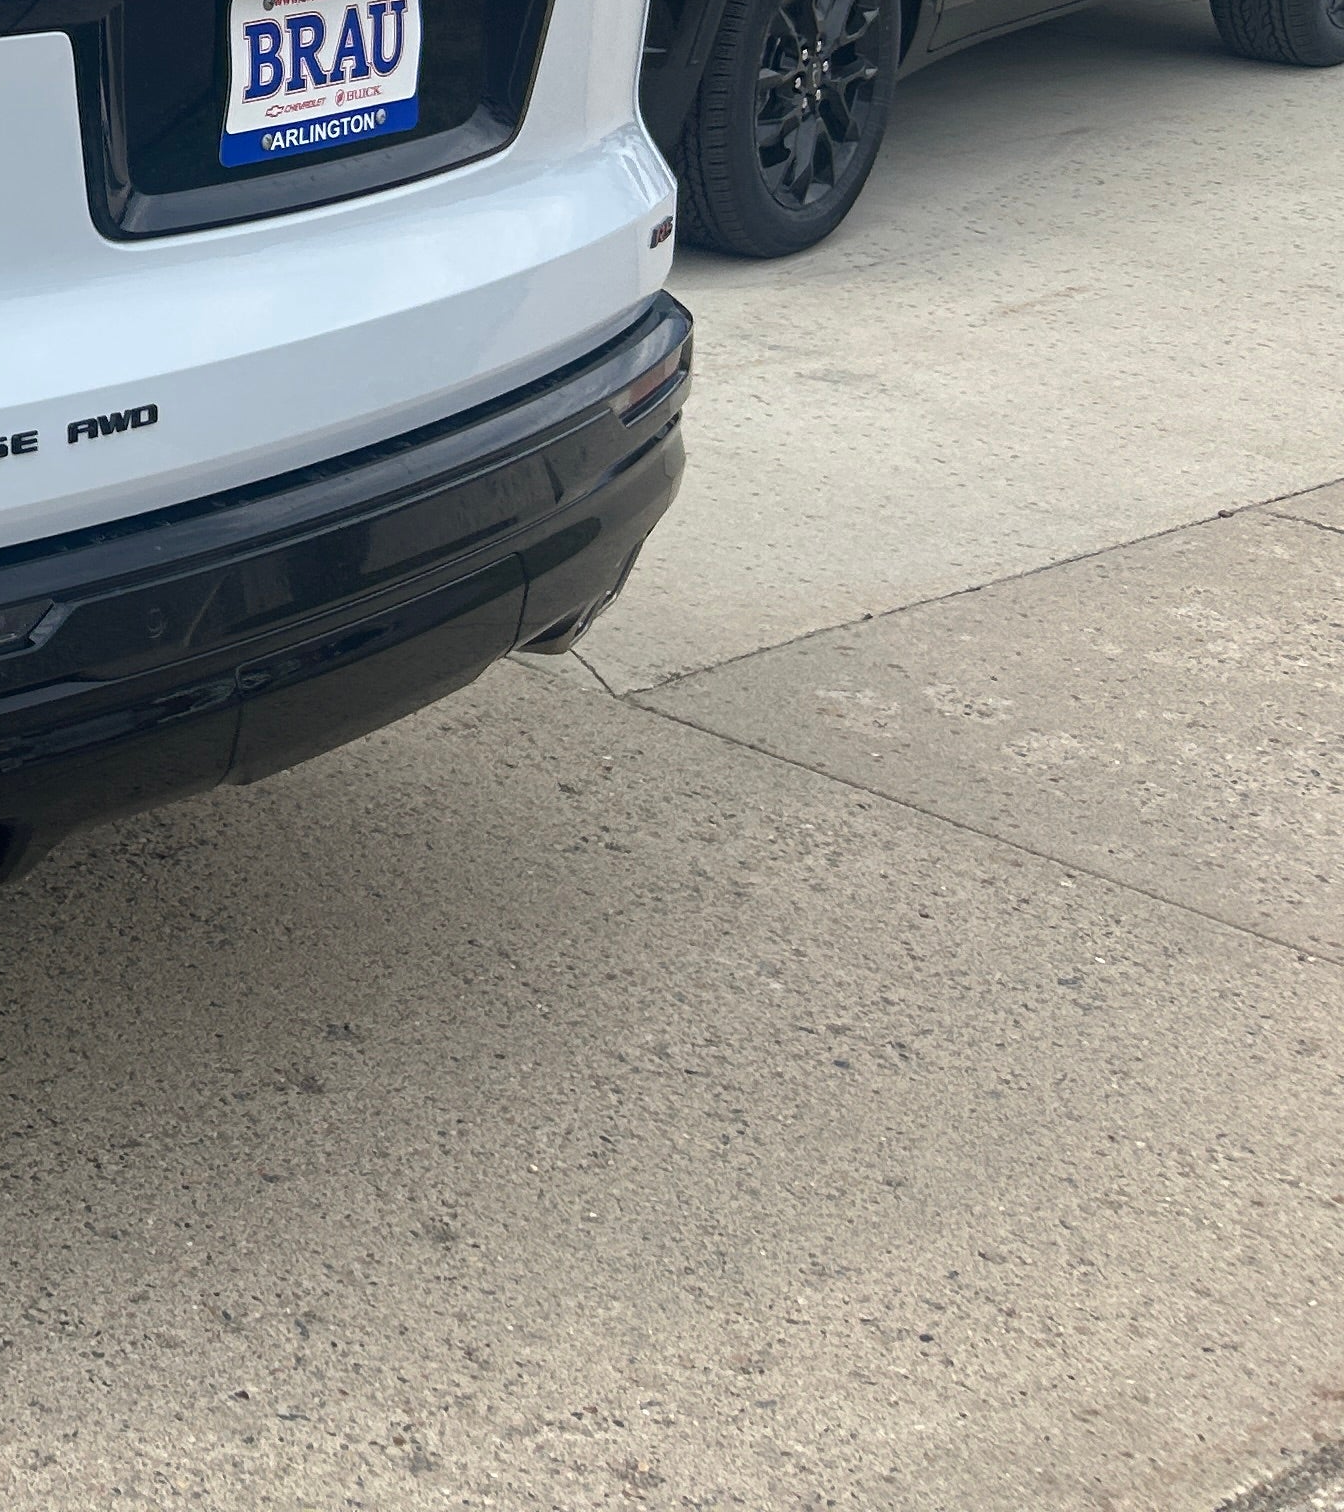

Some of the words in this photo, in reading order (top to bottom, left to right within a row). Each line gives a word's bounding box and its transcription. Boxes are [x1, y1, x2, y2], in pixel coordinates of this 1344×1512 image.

[346, 85, 382, 101] BUICK
[270, 111, 375, 151] ARLINGTON
[66, 403, 159, 445] AWD
